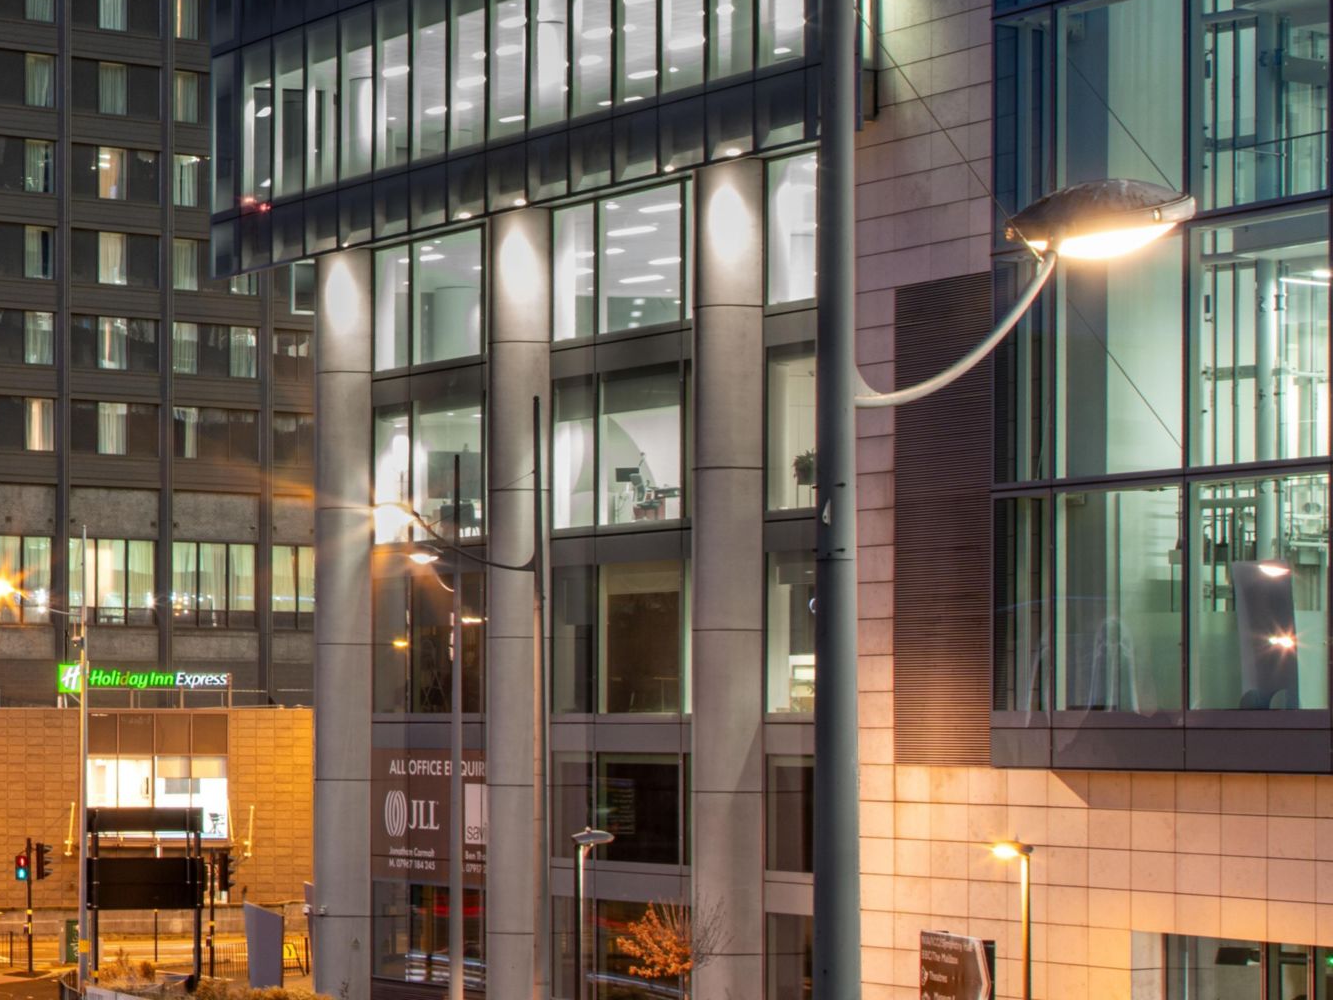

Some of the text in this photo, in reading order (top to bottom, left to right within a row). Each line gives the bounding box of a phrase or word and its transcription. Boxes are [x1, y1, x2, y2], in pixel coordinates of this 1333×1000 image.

[90, 669, 148, 688] Holiday
[149, 672, 174, 686] Inn
[175, 672, 227, 688] Express
[389, 760, 406, 775] ALL
[408, 760, 442, 775] OFFICE
[408, 800, 440, 830] JLL
[465, 851, 476, 860] Ben
